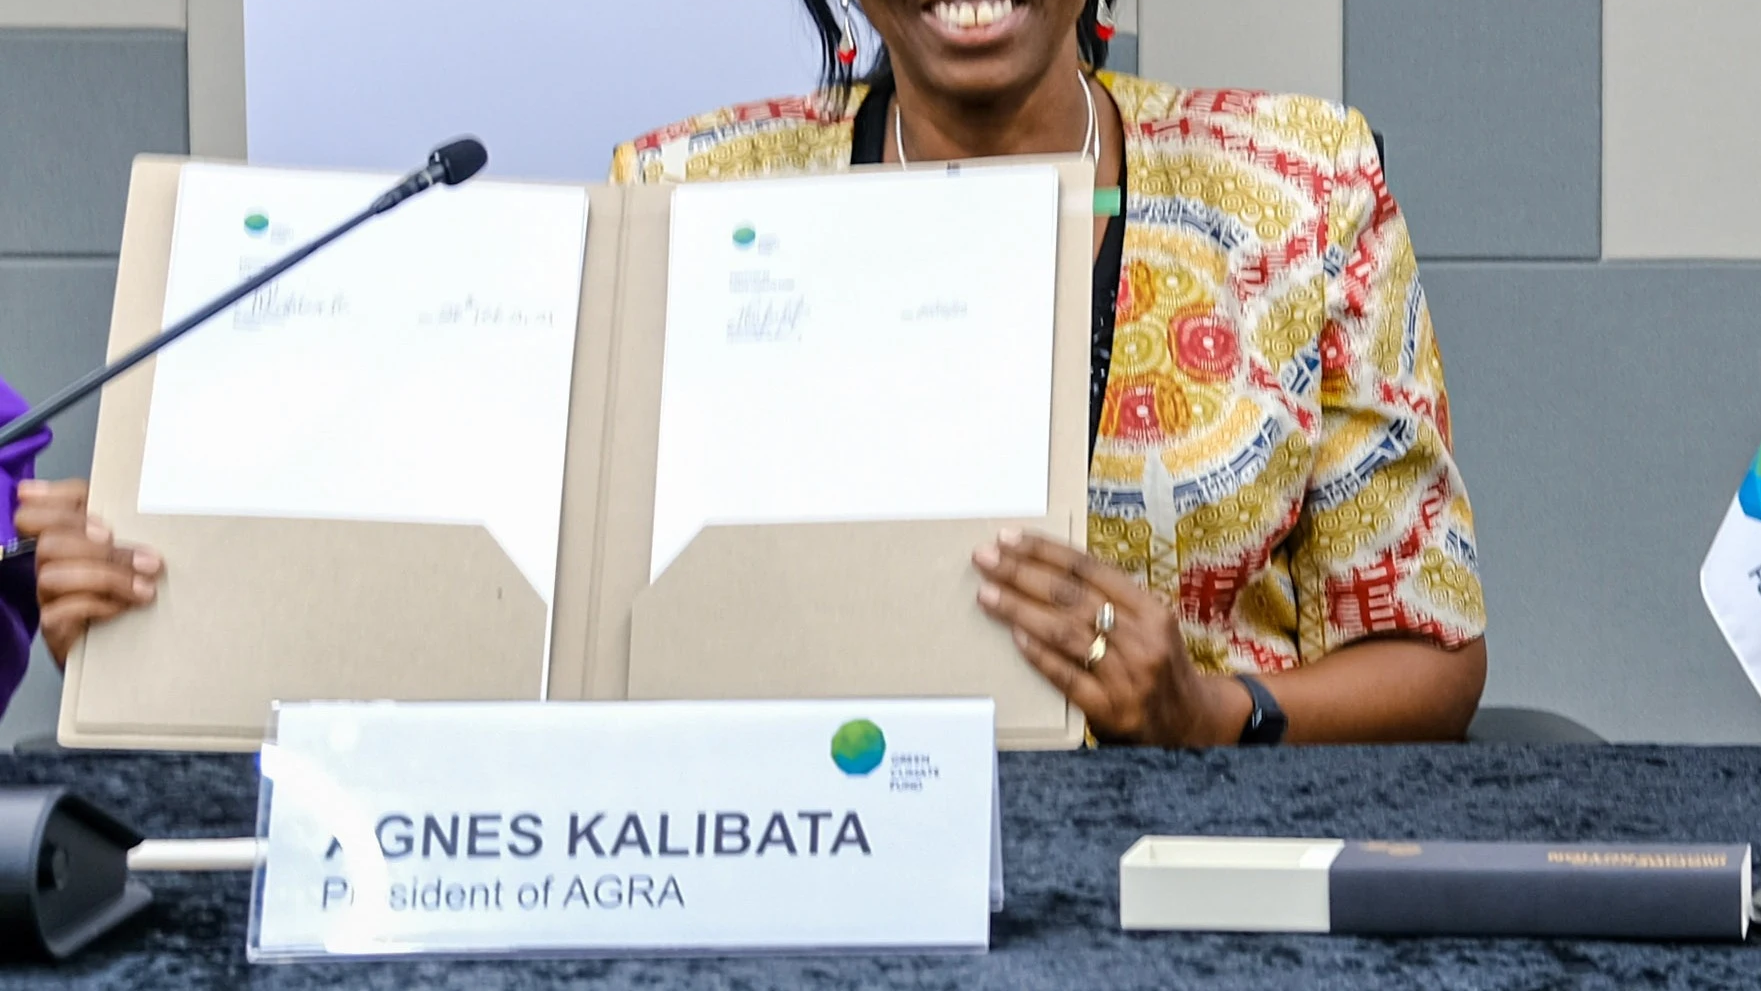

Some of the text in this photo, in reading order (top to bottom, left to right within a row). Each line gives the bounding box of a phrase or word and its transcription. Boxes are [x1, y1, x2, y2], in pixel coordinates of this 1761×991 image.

[566, 810, 873, 858] KALIBATA
[321, 873, 686, 911] Psident of AGRA
